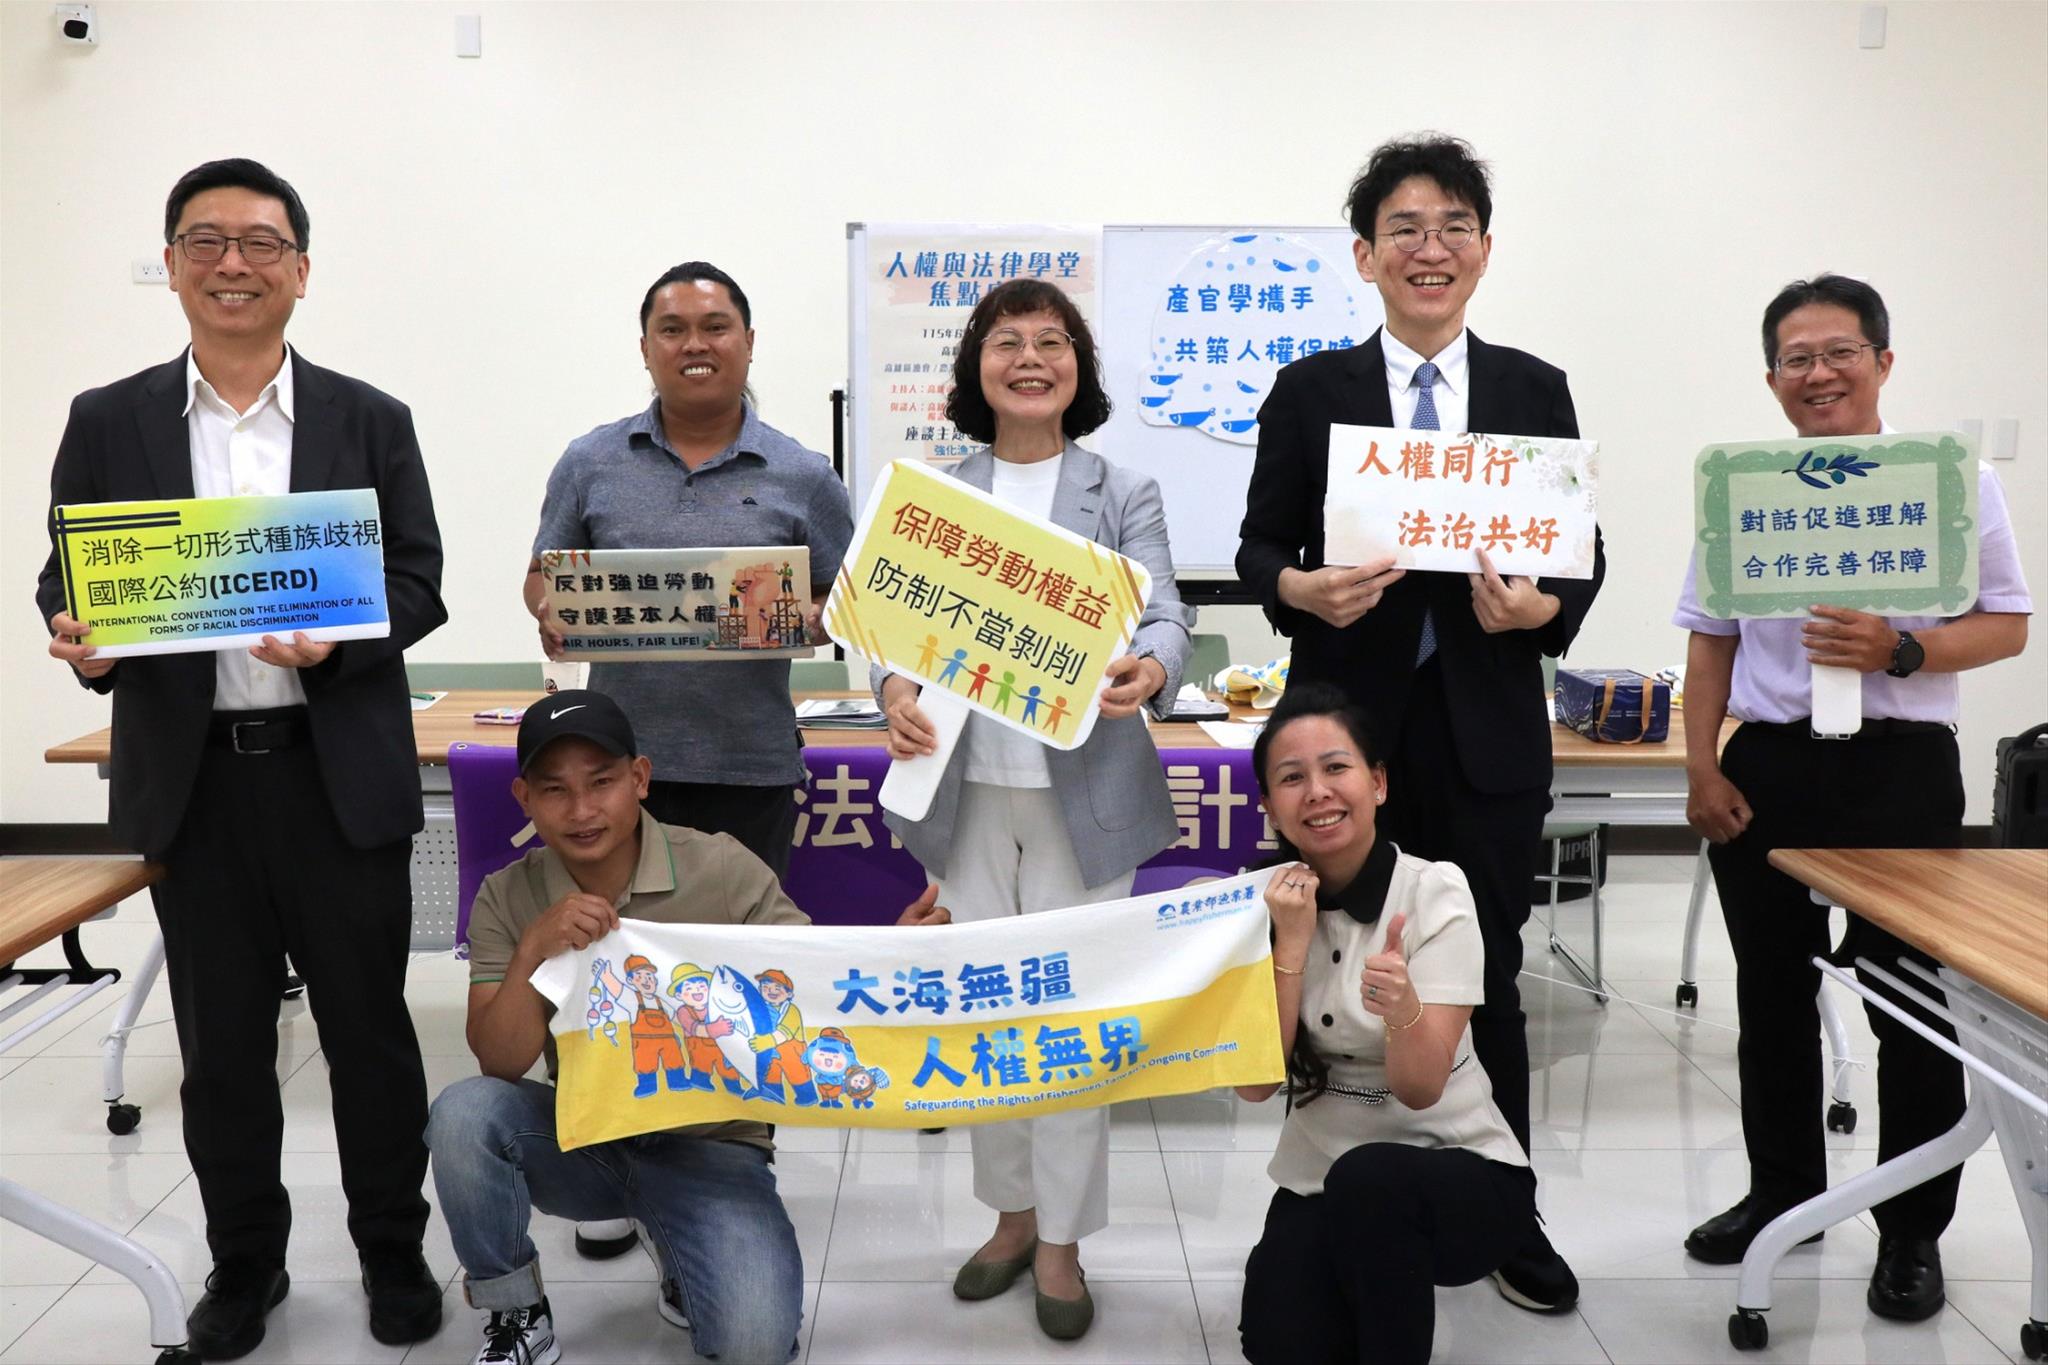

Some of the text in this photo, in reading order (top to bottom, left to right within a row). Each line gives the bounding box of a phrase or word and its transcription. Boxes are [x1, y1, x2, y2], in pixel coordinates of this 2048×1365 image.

[886, 251, 1080, 278] 人權與法律學堂
[929, 281, 1001, 307] 焦點
[1166, 283, 1314, 313] 產官學攜手
[1356, 440, 1519, 487] 人權同行
[1398, 509, 1560, 555] 法治共好
[1740, 501, 1928, 533] 對話促進理解
[82, 519, 381, 567] 消除一切形式種族歧視
[891, 501, 1112, 630] 保障勞動權益
[1742, 548, 1928, 579] 合作完善保障
[88, 567, 318, 607] 國際公約(ICERD)
[555, 572, 715, 593] 反對強迫勞動
[89, 597, 374, 628] INTERNATIONAL CONVENTION ON THE ELIMINATION OF ALL
[150, 613, 319, 635] FORMS OF RACIAL DISCRIMINATION
[558, 605, 718, 626] 守護基本人權
[867, 557, 1088, 686] 防制不當剝削
[562, 638, 583, 648] AIR
[638, 637, 666, 647] FAIR
[672, 636, 700, 646] LIFE!
[833, 951, 1076, 1016] 大海無疆
[911, 1015, 1149, 1091] 人權無界
[905, 1098, 976, 1113] Safeguarding
[977, 1096, 995, 1106] the
[998, 1094, 1032, 1107] Rights
[1033, 1092, 1045, 1102] of
[1148, 1051, 1191, 1066] Ongoing
